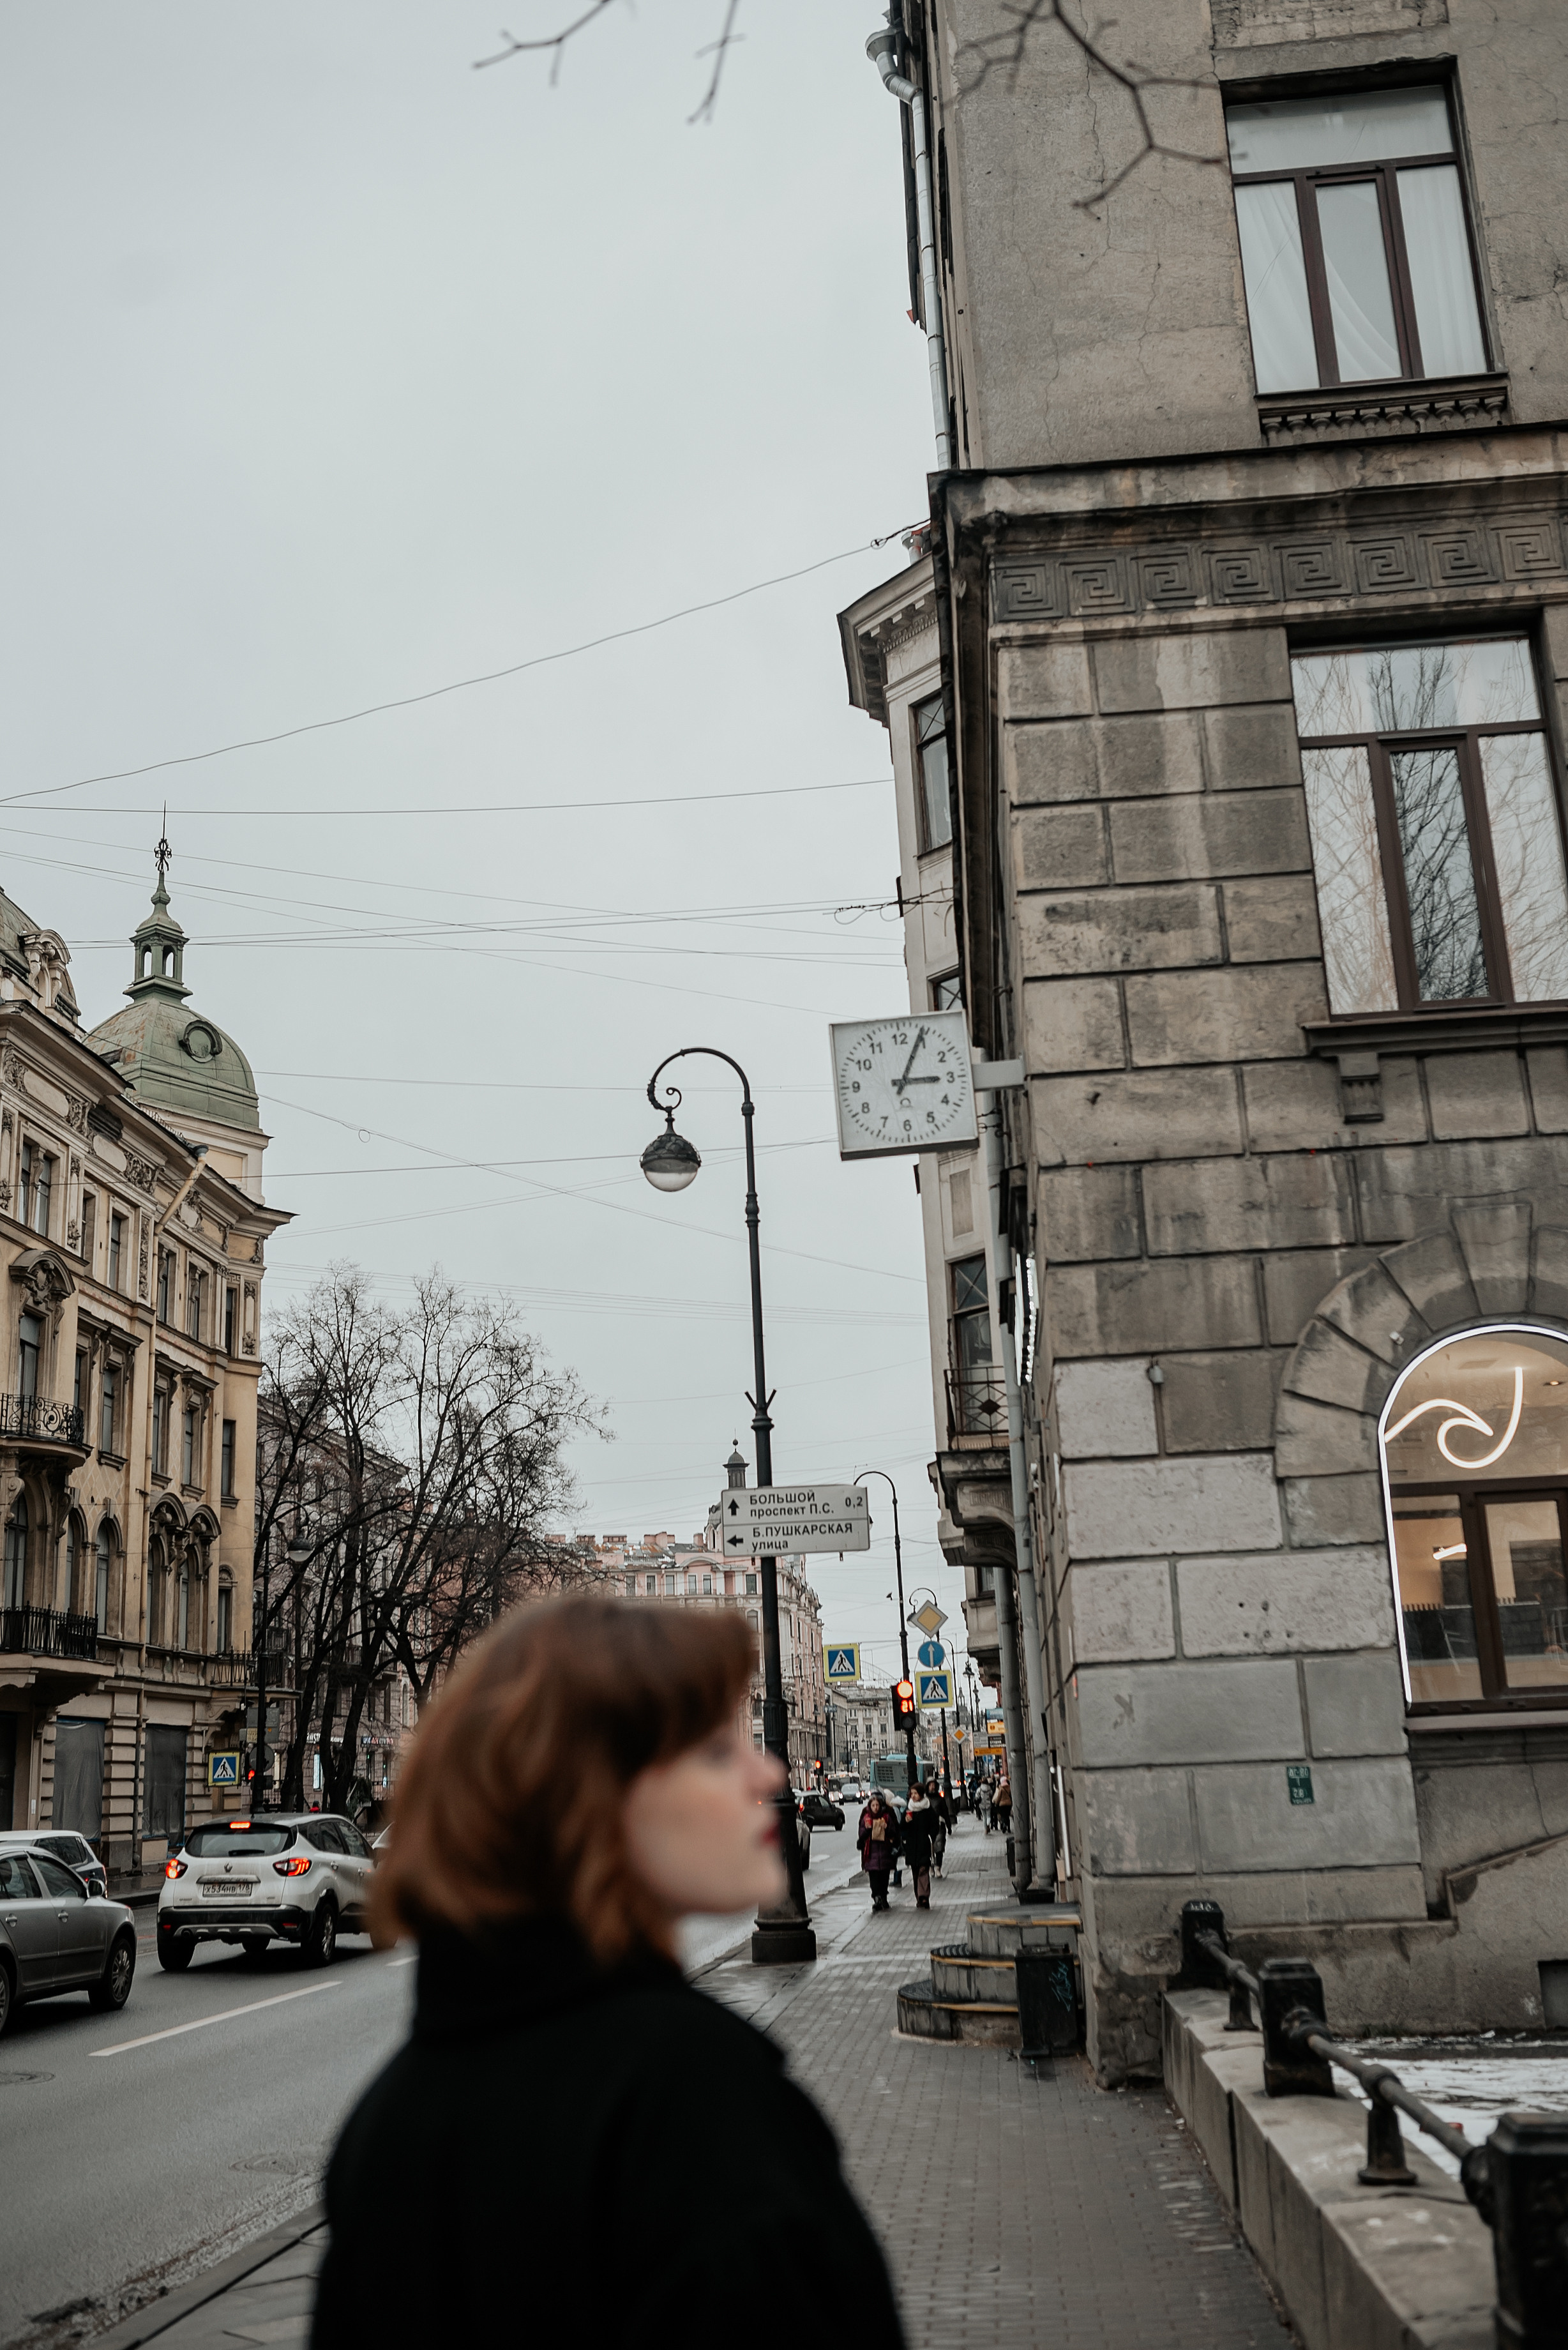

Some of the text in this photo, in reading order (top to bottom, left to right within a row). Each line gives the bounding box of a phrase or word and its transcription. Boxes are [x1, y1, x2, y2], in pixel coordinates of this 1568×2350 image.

[892, 1033, 907, 1045] 12
[869, 1042, 882, 1054] 11
[938, 1051, 946, 1063] 2
[856, 1059, 872, 1071] 10
[947, 1072, 955, 1083] 3
[852, 1081, 860, 1093] 9
[941, 1094, 950, 1105] 4
[862, 1102, 870, 1113] 8
[880, 1116, 889, 1128] 7
[927, 1112, 935, 1123] 5
[903, 1119, 912, 1131] 6
[750, 1489, 815, 1505] БОЛЬШОЙ
[845, 1496, 863, 1509] 0,2
[750, 1503, 834, 1519] проспект П.С.
[753, 1523, 853, 1538] Б.ПУШКАРСКАЯ
[752, 1539, 788, 1553] улица
